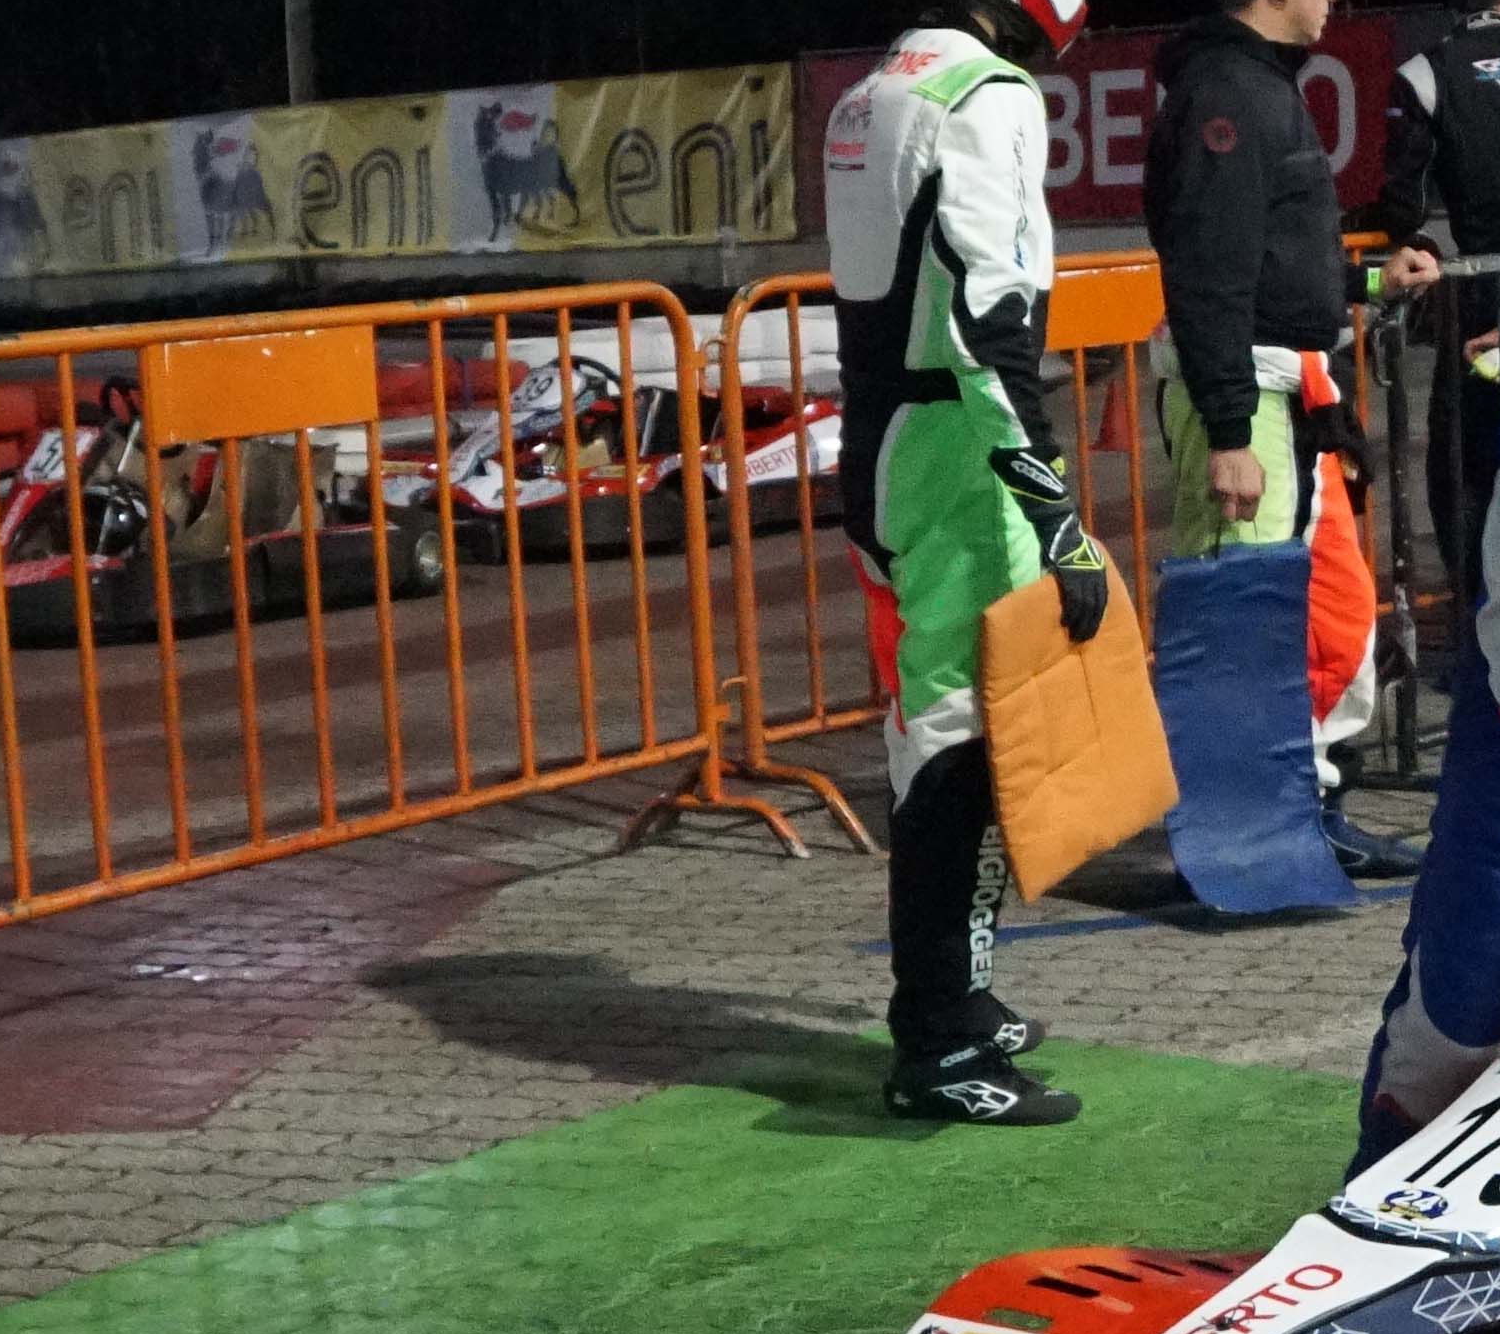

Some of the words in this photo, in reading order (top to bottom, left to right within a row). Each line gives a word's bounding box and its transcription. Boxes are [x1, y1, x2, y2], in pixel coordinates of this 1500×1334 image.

[64, 134, 163, 265] eni
[299, 106, 436, 249] eni
[605, 77, 772, 238] eni
